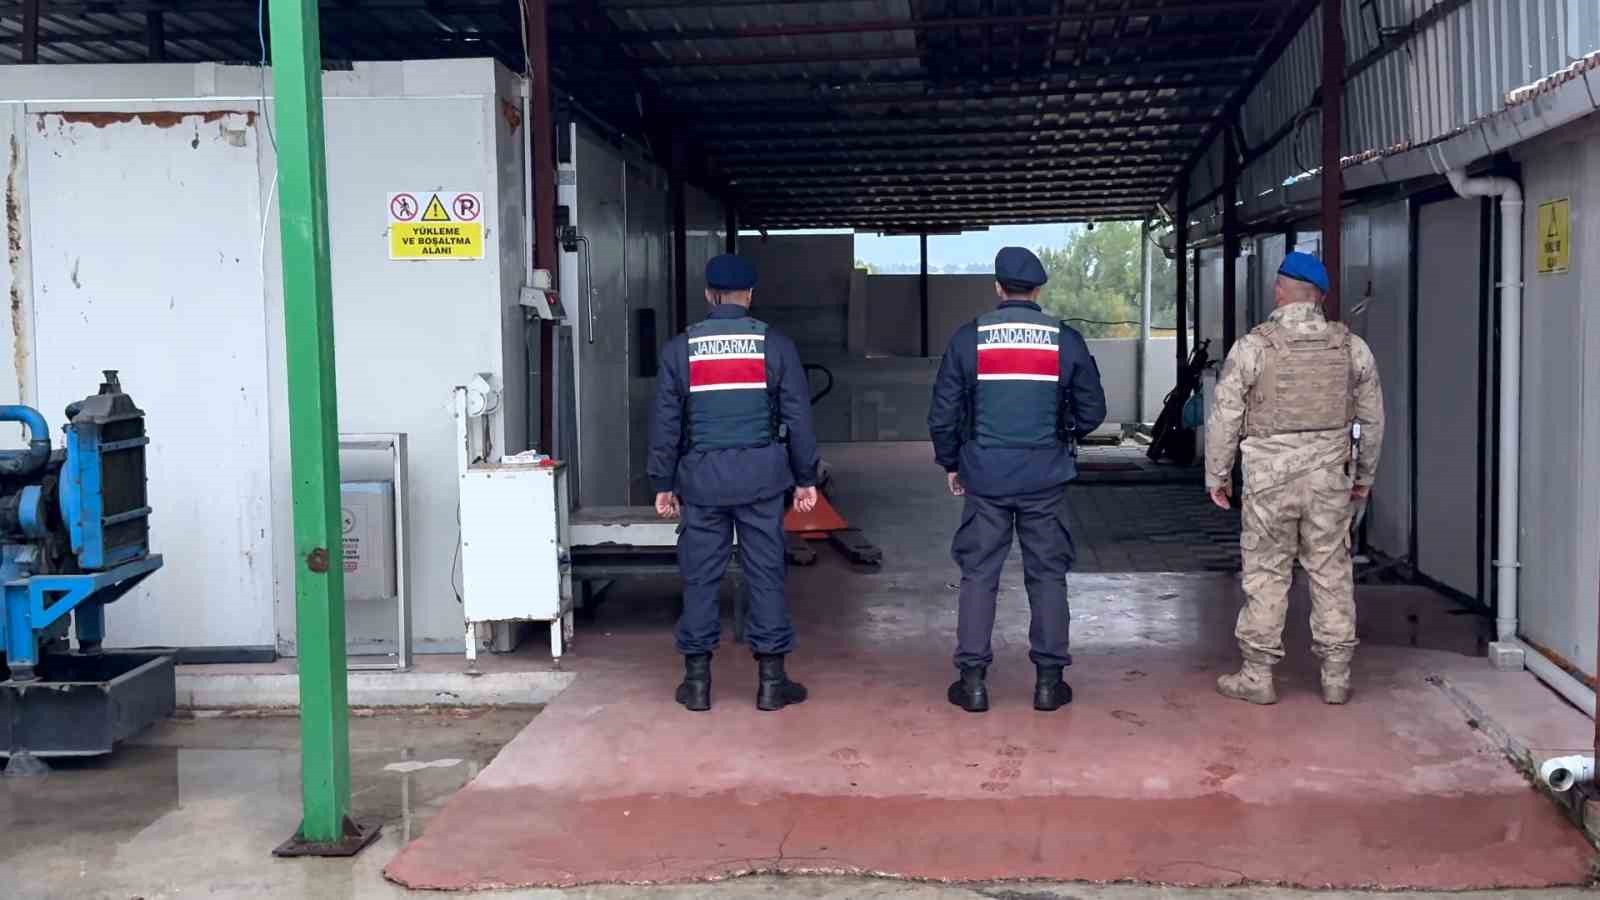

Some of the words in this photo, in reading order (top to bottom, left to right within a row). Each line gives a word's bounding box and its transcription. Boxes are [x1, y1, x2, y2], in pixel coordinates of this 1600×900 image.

[413, 226, 460, 236] YÜKLEME
[402, 237, 415, 245] VE
[418, 237, 472, 247] BOŞALTMA
[422, 247, 452, 255] ALANI
[985, 327, 1052, 345] JANDARMA
[694, 339, 757, 356] JANDARMA
